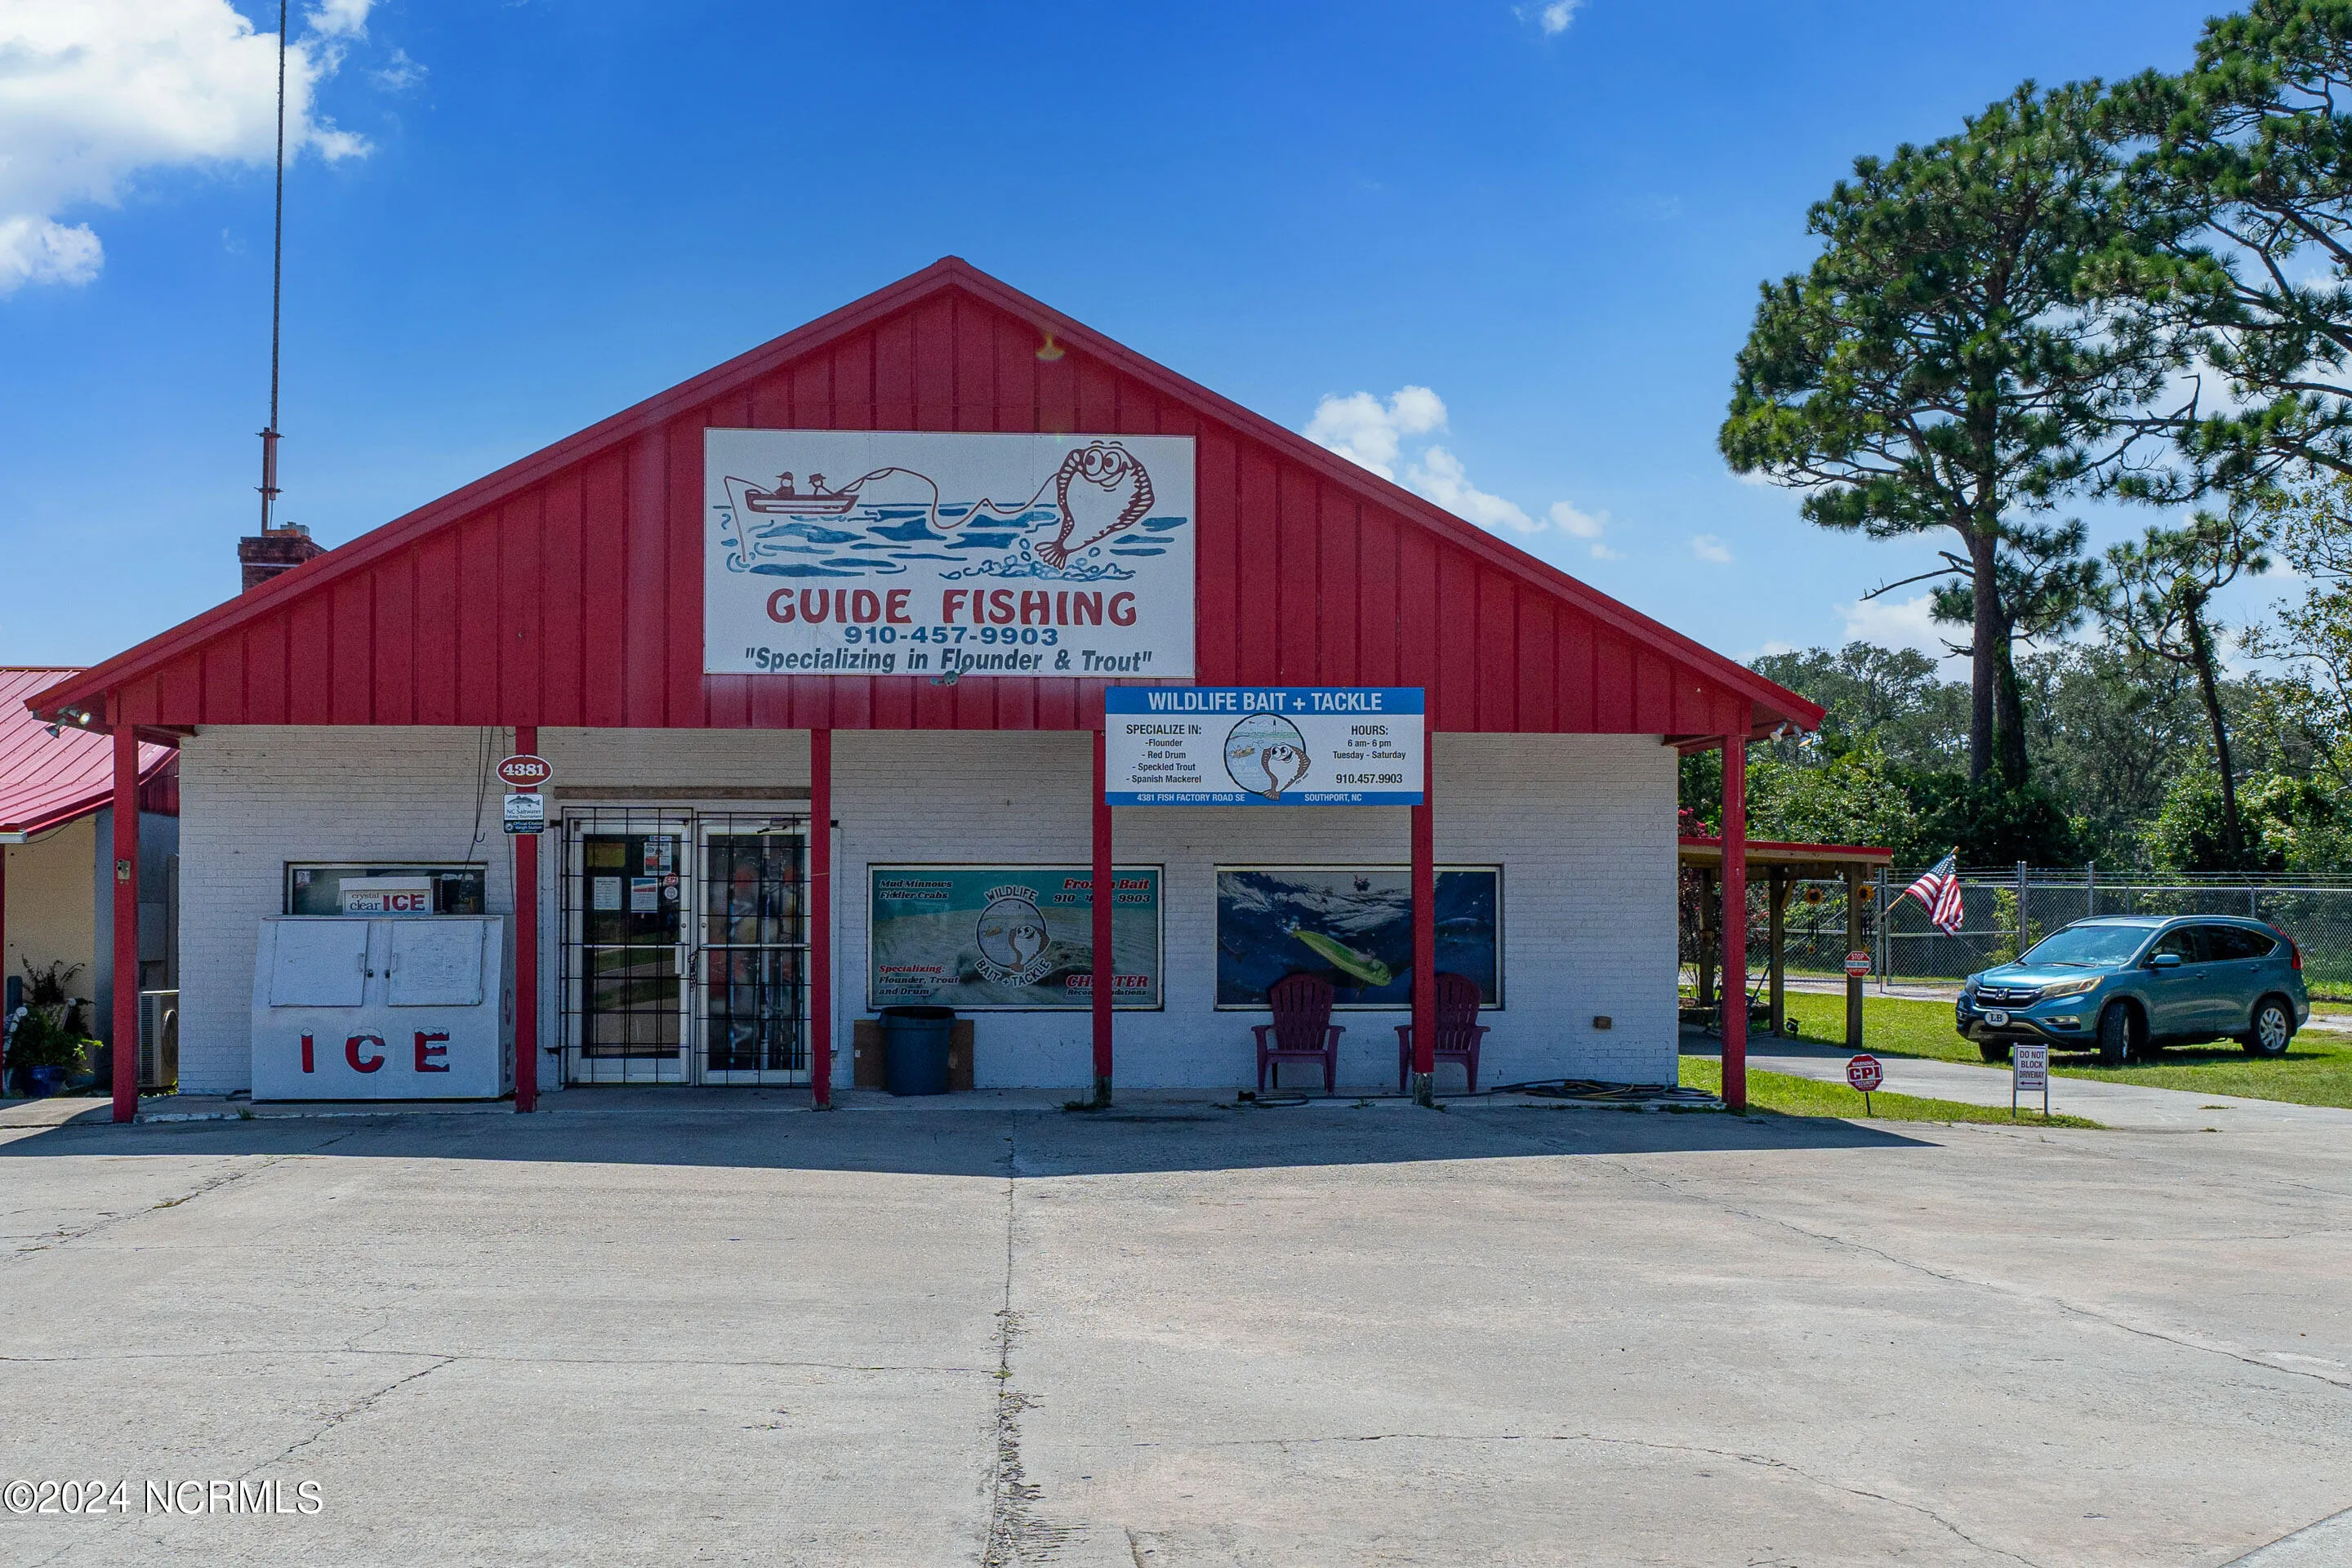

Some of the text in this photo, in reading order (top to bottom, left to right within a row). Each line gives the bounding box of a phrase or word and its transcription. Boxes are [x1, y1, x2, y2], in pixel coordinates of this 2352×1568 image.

[766, 587, 1137, 626] GUIDE FISHING
[844, 626, 1058, 646] 910-457-9903
[745, 647, 1152, 674] "Specializing in Flounder & Trout"
[1147, 692, 1382, 710] WILDLIFE BAIT + TACKLE
[1126, 724, 1201, 735] SPECIALIZE IN:
[1351, 725, 1388, 735] HOURS:
[1348, 739, 1352, 747] 6
[1372, 739, 1377, 747] 6
[1147, 751, 1162, 759] Red
[1165, 751, 1186, 759] Drum
[1333, 751, 1364, 760] Tuesday
[1372, 751, 1405, 760] Saturday
[503, 764, 545, 776] 4381
[1138, 763, 1174, 772] Speckled
[1176, 763, 1196, 771] Trout
[1132, 774, 1163, 784] Spanish
[1165, 775, 1201, 783] Mackerel
[1336, 773, 1403, 784] 910.457.9903
[1137, 793, 1245, 801] 4381 FISH FACTORY ROAD SE
[1304, 793, 1362, 802] SOUTHPORT, NC
[880, 880, 953, 888] Mud Minnows
[1119, 878, 1150, 889] Bait
[880, 890, 948, 899] Fiddler Crabs
[985, 886, 1038, 902] WILDLIFE
[1054, 894, 1076, 902] 910
[1118, 894, 1150, 902] 9903
[350, 893, 425, 911] clear ICE
[879, 964, 946, 973] Specializing:
[976, 959, 1001, 982] BAIT
[1011, 959, 1050, 987] TACKLE
[879, 976, 960, 984] Flounder, Trout
[1067, 975, 1149, 987] CHTER
[1990, 1013, 2003, 1022] LB
[301, 1026, 450, 1074] ICE
[1849, 1067, 1881, 1080] CPI
[2019, 1070, 2045, 1078] DRIVEWAY
